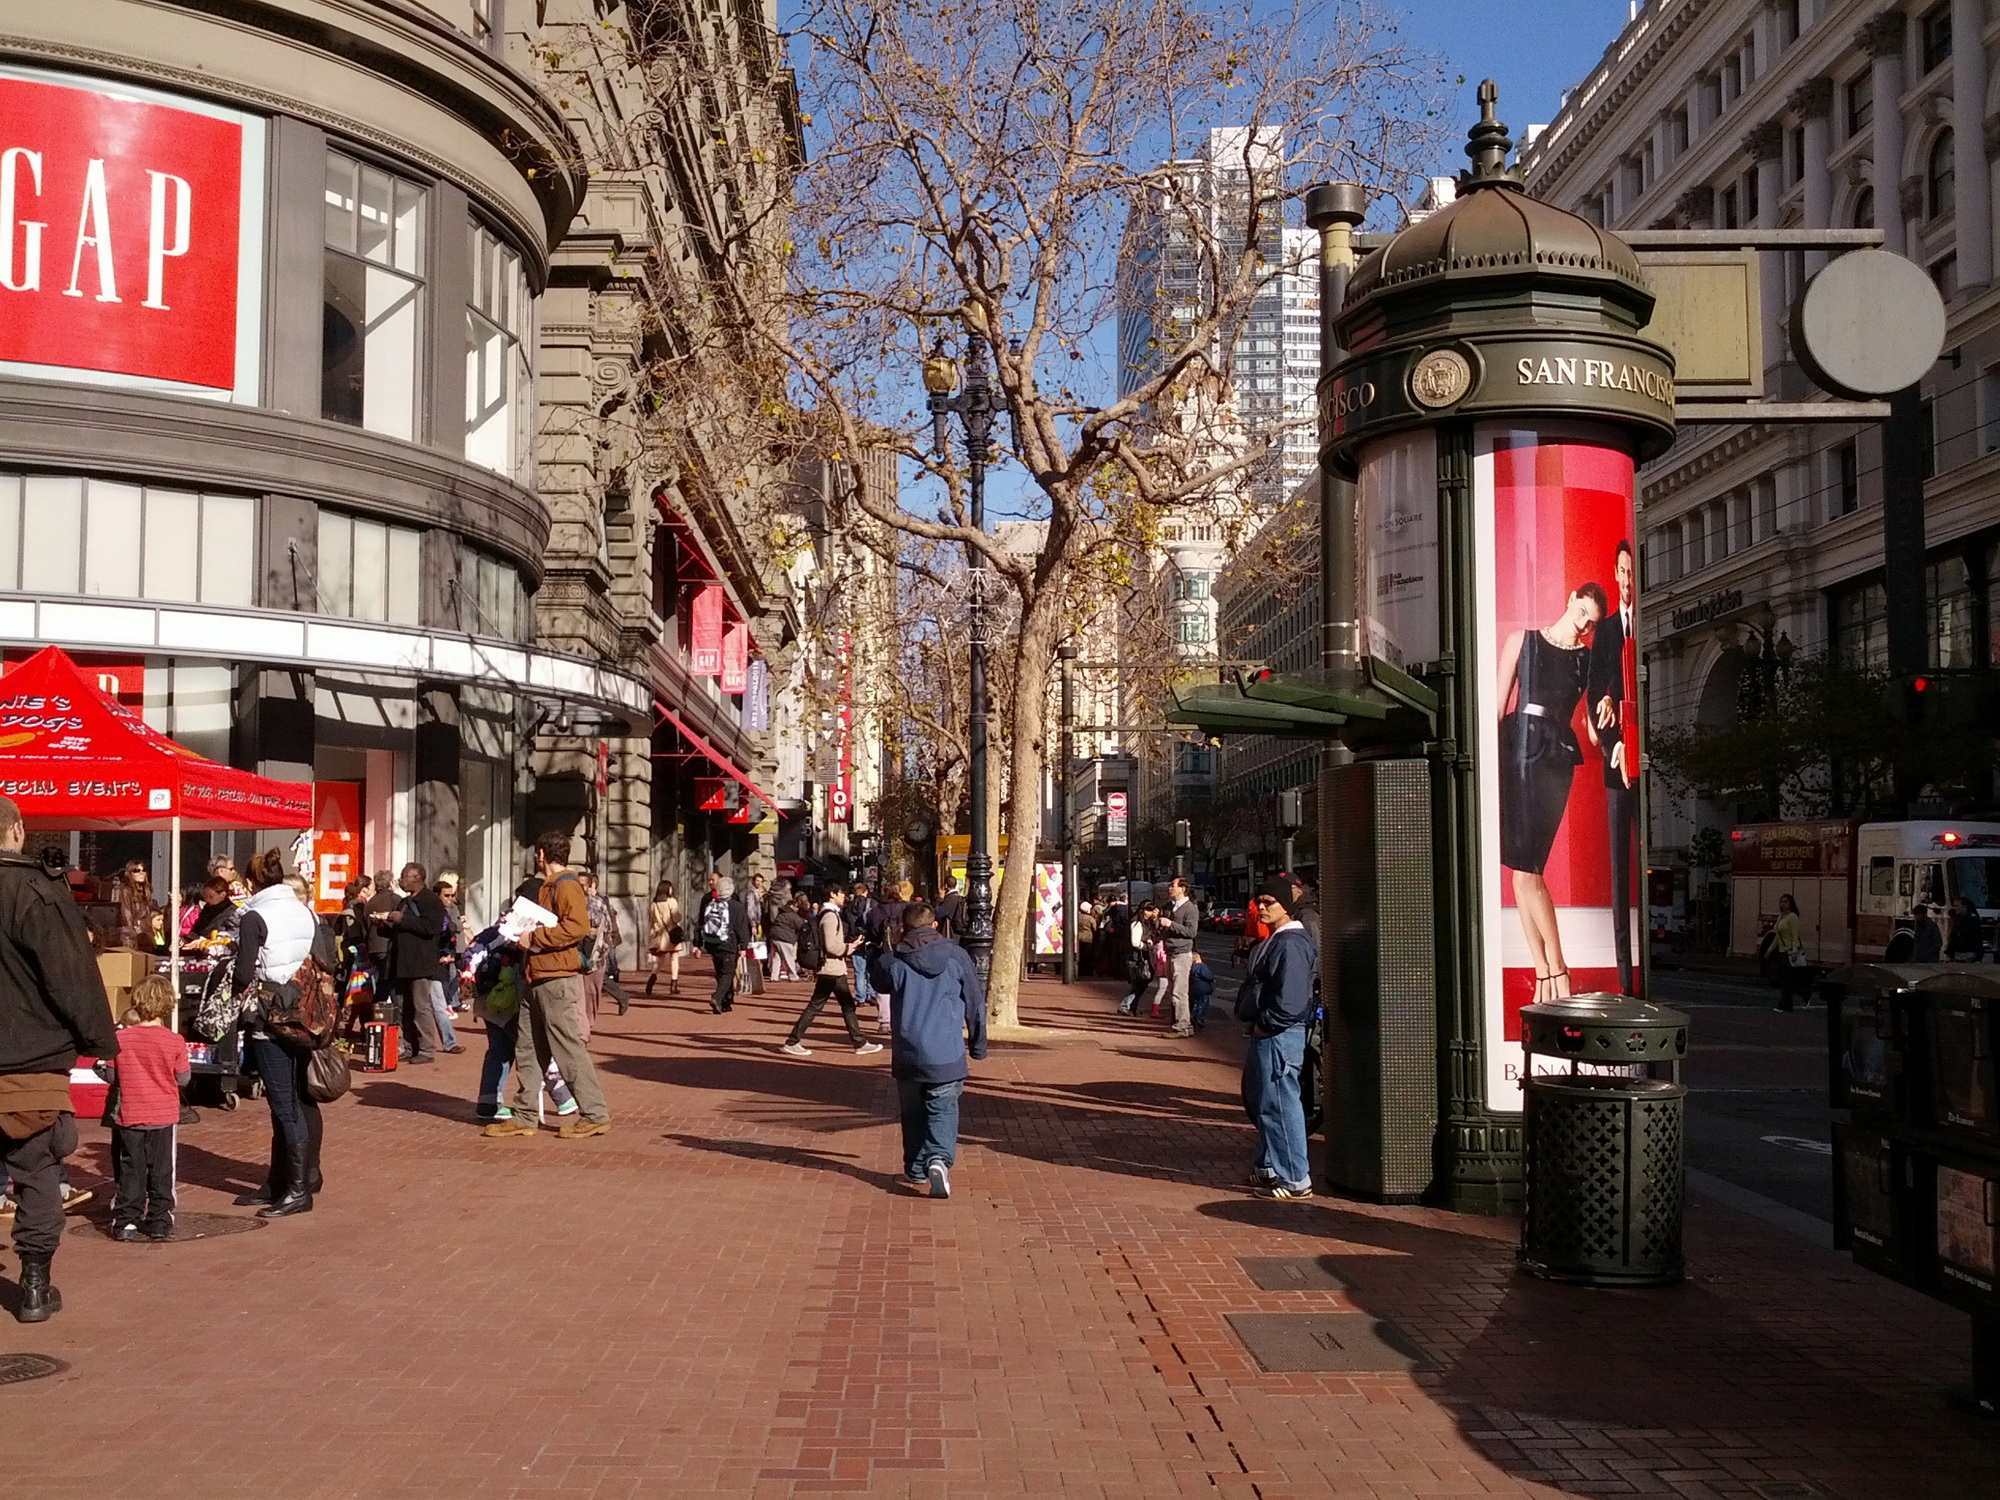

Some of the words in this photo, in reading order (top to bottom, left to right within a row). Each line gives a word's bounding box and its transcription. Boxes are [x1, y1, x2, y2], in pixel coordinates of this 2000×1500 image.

[0, 145, 191, 311] GAP
[1517, 357, 1579, 386] SAN
[1395, 513, 1423, 527] SQUARE
[699, 655, 715, 667] GAP
[68, 780, 143, 797] EVENTS
[1760, 846, 1774, 859] FIRE
[1775, 846, 1815, 859] DEPARTMENT
